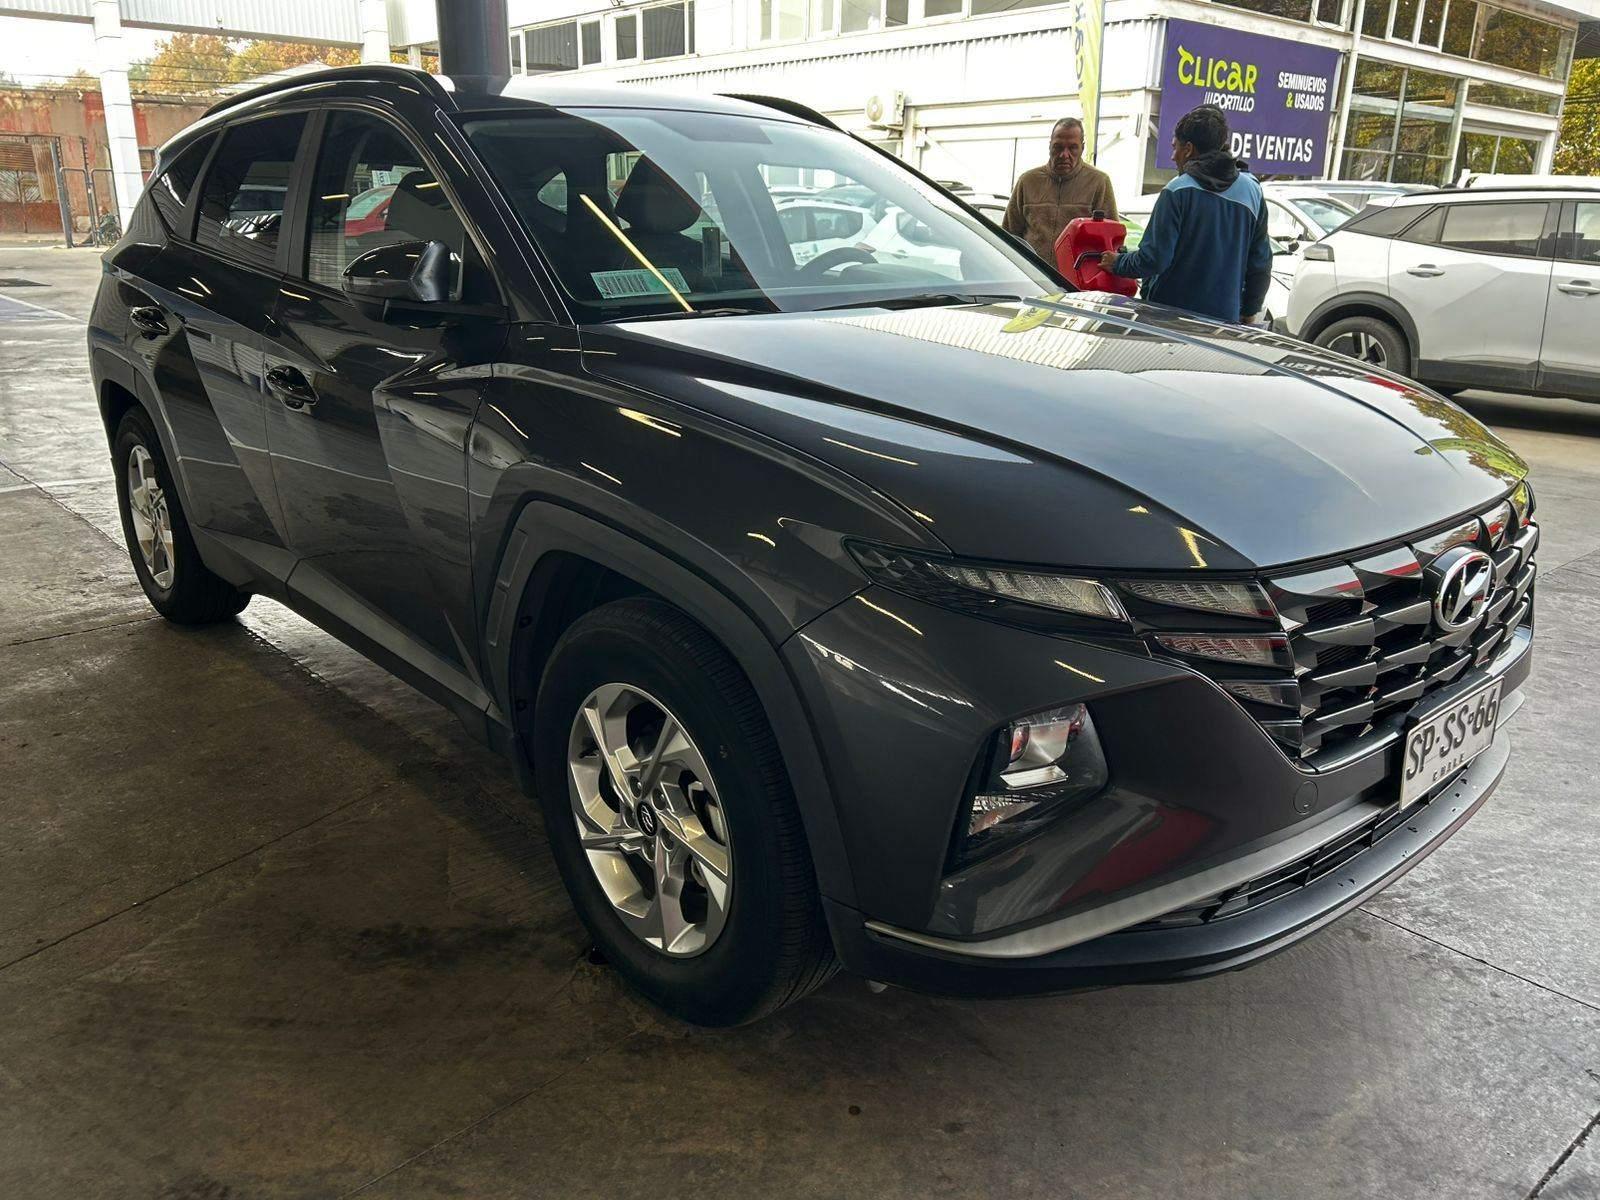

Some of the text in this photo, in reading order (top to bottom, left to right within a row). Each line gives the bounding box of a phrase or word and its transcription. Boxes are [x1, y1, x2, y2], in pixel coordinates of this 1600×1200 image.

[1277, 71, 1327, 94] SEMINUEVOS
[1286, 92, 1325, 111] & USADOS
[1230, 132, 1313, 162] DE VENTAS
[1433, 753, 1464, 782] CHILE
